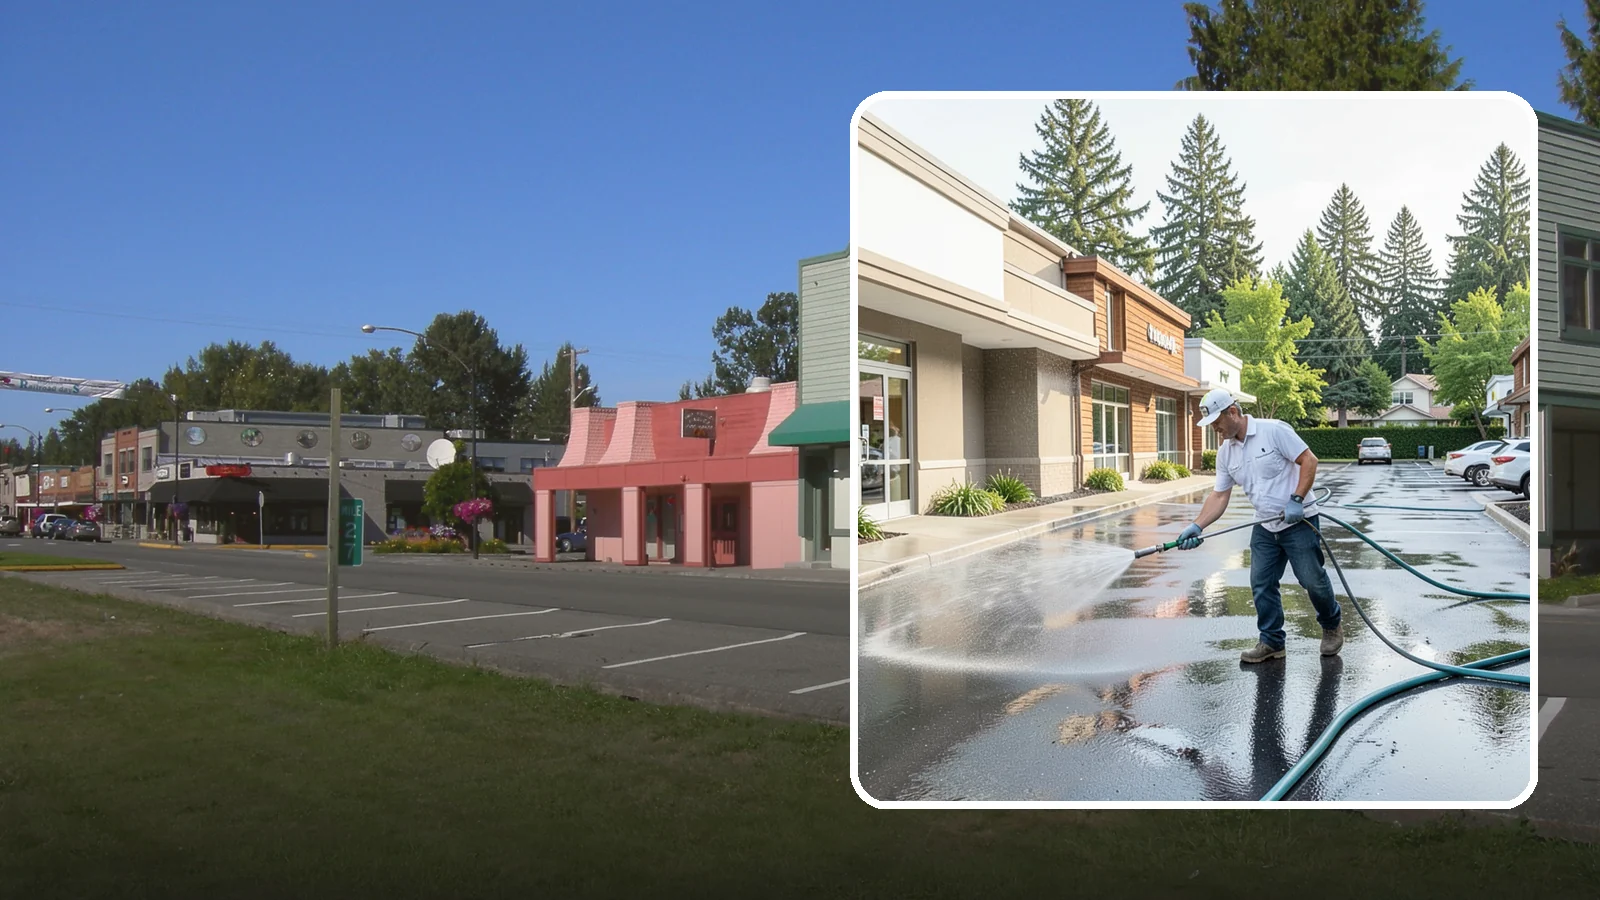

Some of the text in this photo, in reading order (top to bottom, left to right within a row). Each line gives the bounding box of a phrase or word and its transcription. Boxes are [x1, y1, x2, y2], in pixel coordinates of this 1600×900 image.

[20, 379, 57, 391] Railroad
[341, 505, 362, 517] MILE
[345, 522, 357, 539] 2
[344, 543, 356, 560] 7
